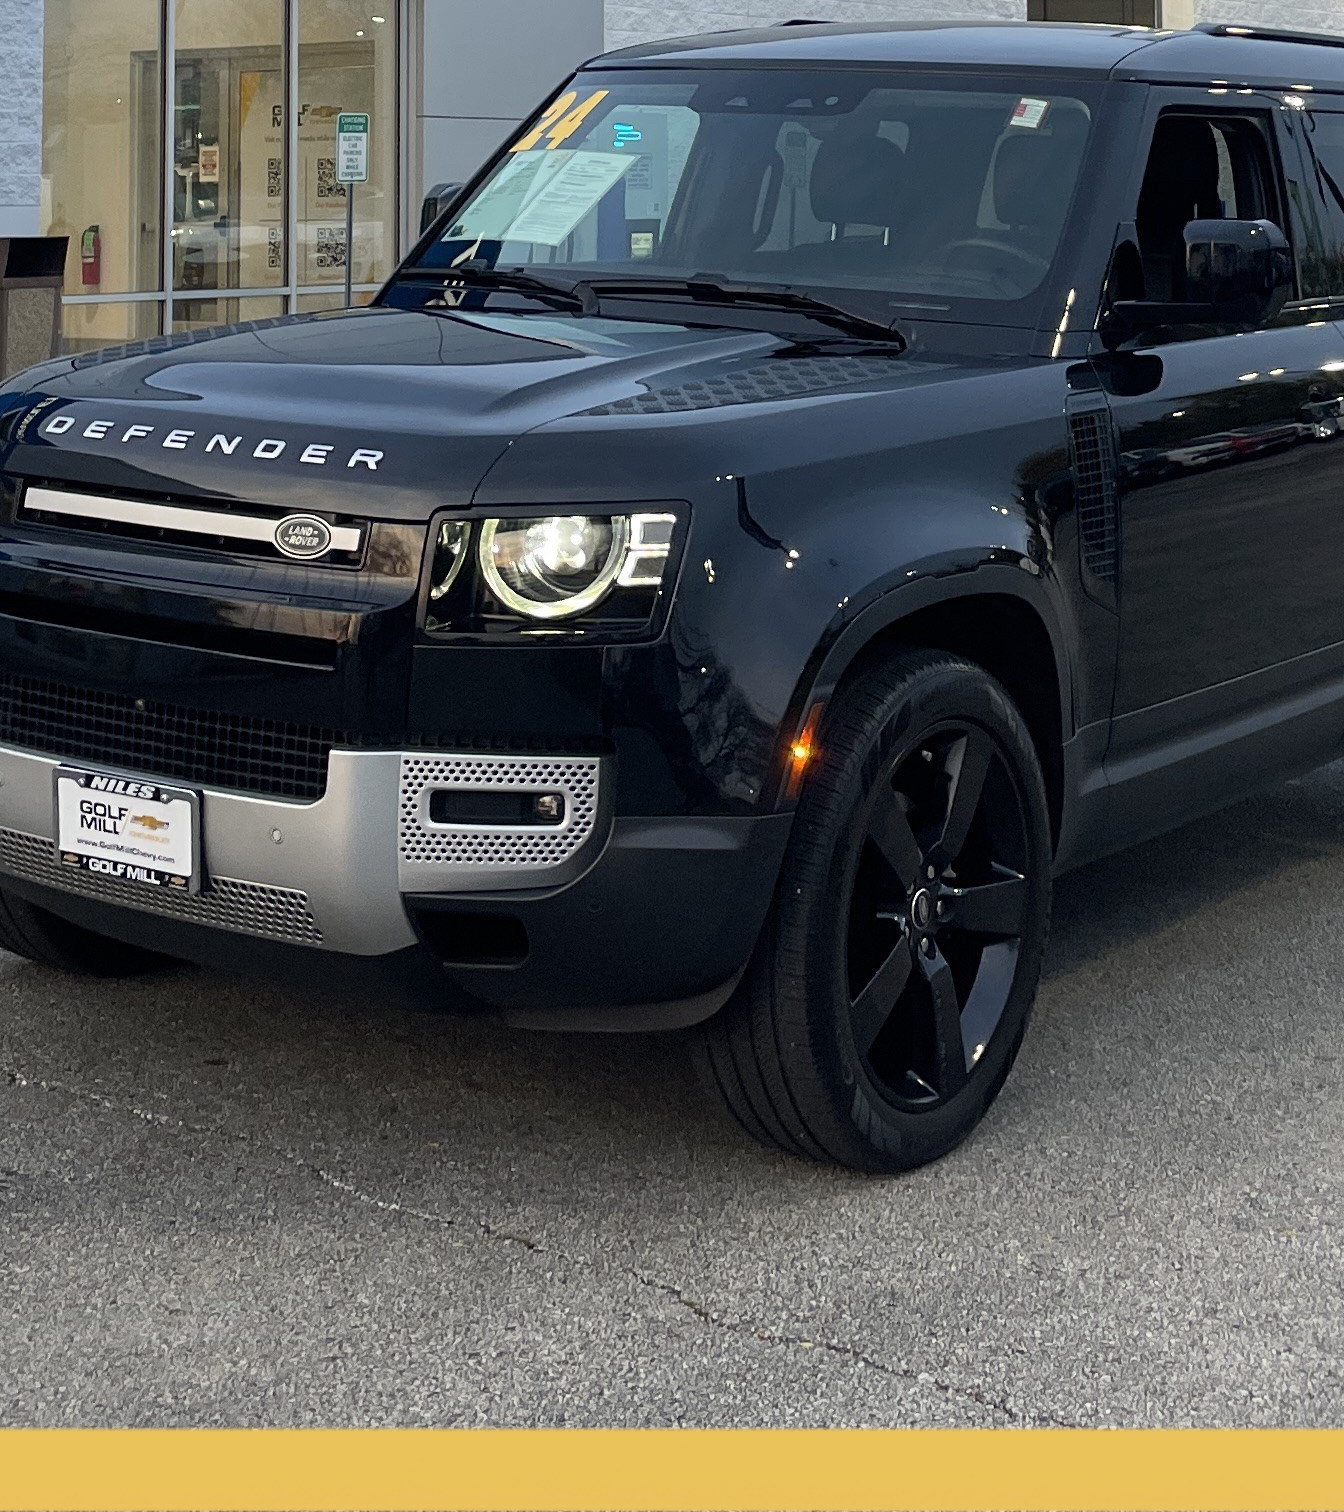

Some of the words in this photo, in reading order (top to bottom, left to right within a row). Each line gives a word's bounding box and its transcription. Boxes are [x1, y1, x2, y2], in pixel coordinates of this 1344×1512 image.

[508, 90, 610, 152] 24
[45, 415, 385, 470] DEFENDER
[90, 775, 157, 800] NILES
[79, 799, 129, 821] GOLF
[80, 814, 120, 836] MILL
[88, 857, 126, 877] GOLF
[126, 864, 161, 886] MILL
